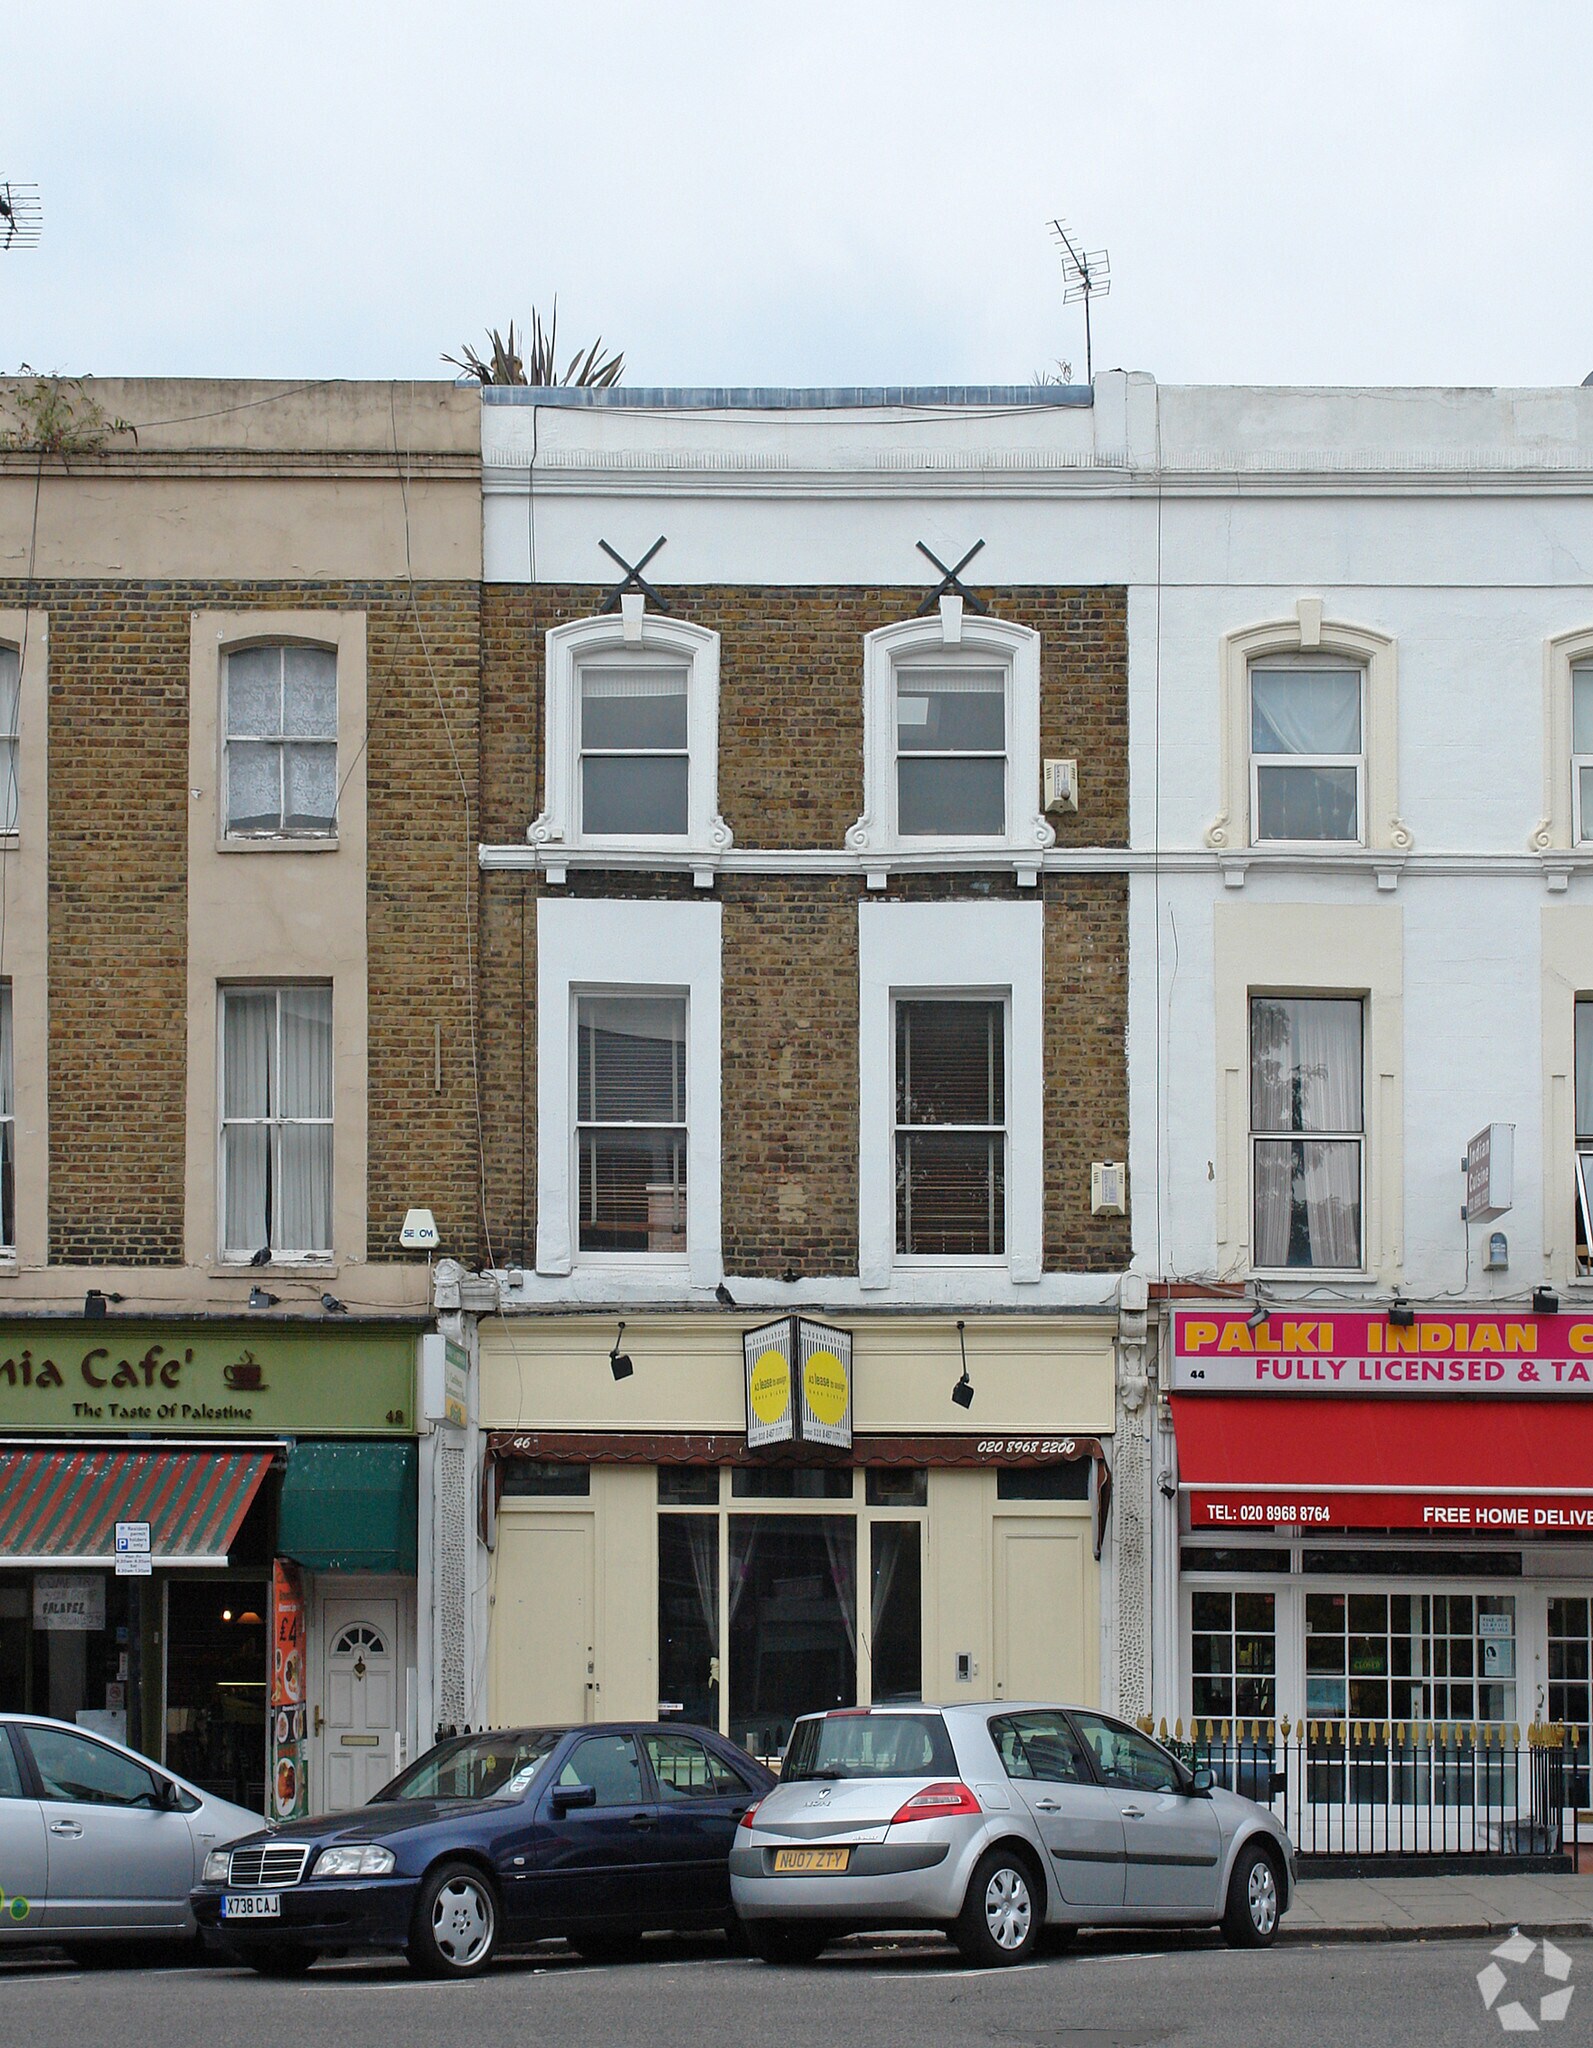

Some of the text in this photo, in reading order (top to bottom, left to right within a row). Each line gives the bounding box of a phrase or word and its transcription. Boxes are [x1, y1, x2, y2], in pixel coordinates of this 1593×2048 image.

[1469, 1139, 1490, 1166] Indian
[1469, 1168, 1489, 1193] Cuisine
[1183, 1321, 1334, 1353] PALKI
[1367, 1322, 1538, 1354] INDIAN
[1189, 1369, 1206, 1380] 44
[1256, 1359, 1591, 1382] FULLY LICENSED & TA
[759, 1378, 772, 1390] lease
[814, 1373, 830, 1388] lease
[72, 1402, 252, 1420] The Taste Of Palestine
[385, 1409, 404, 1424] 48
[513, 1436, 531, 1449] 46
[977, 1441, 1076, 1454] 020 8968 2200
[1206, 1504, 1330, 1522] TEL: 020 8968 8764
[1423, 1507, 1593, 1526] FREE HOME DELIVE
[779, 1852, 843, 1868] NU07 ZTY
[227, 1897, 278, 1914] X738 CAJ
